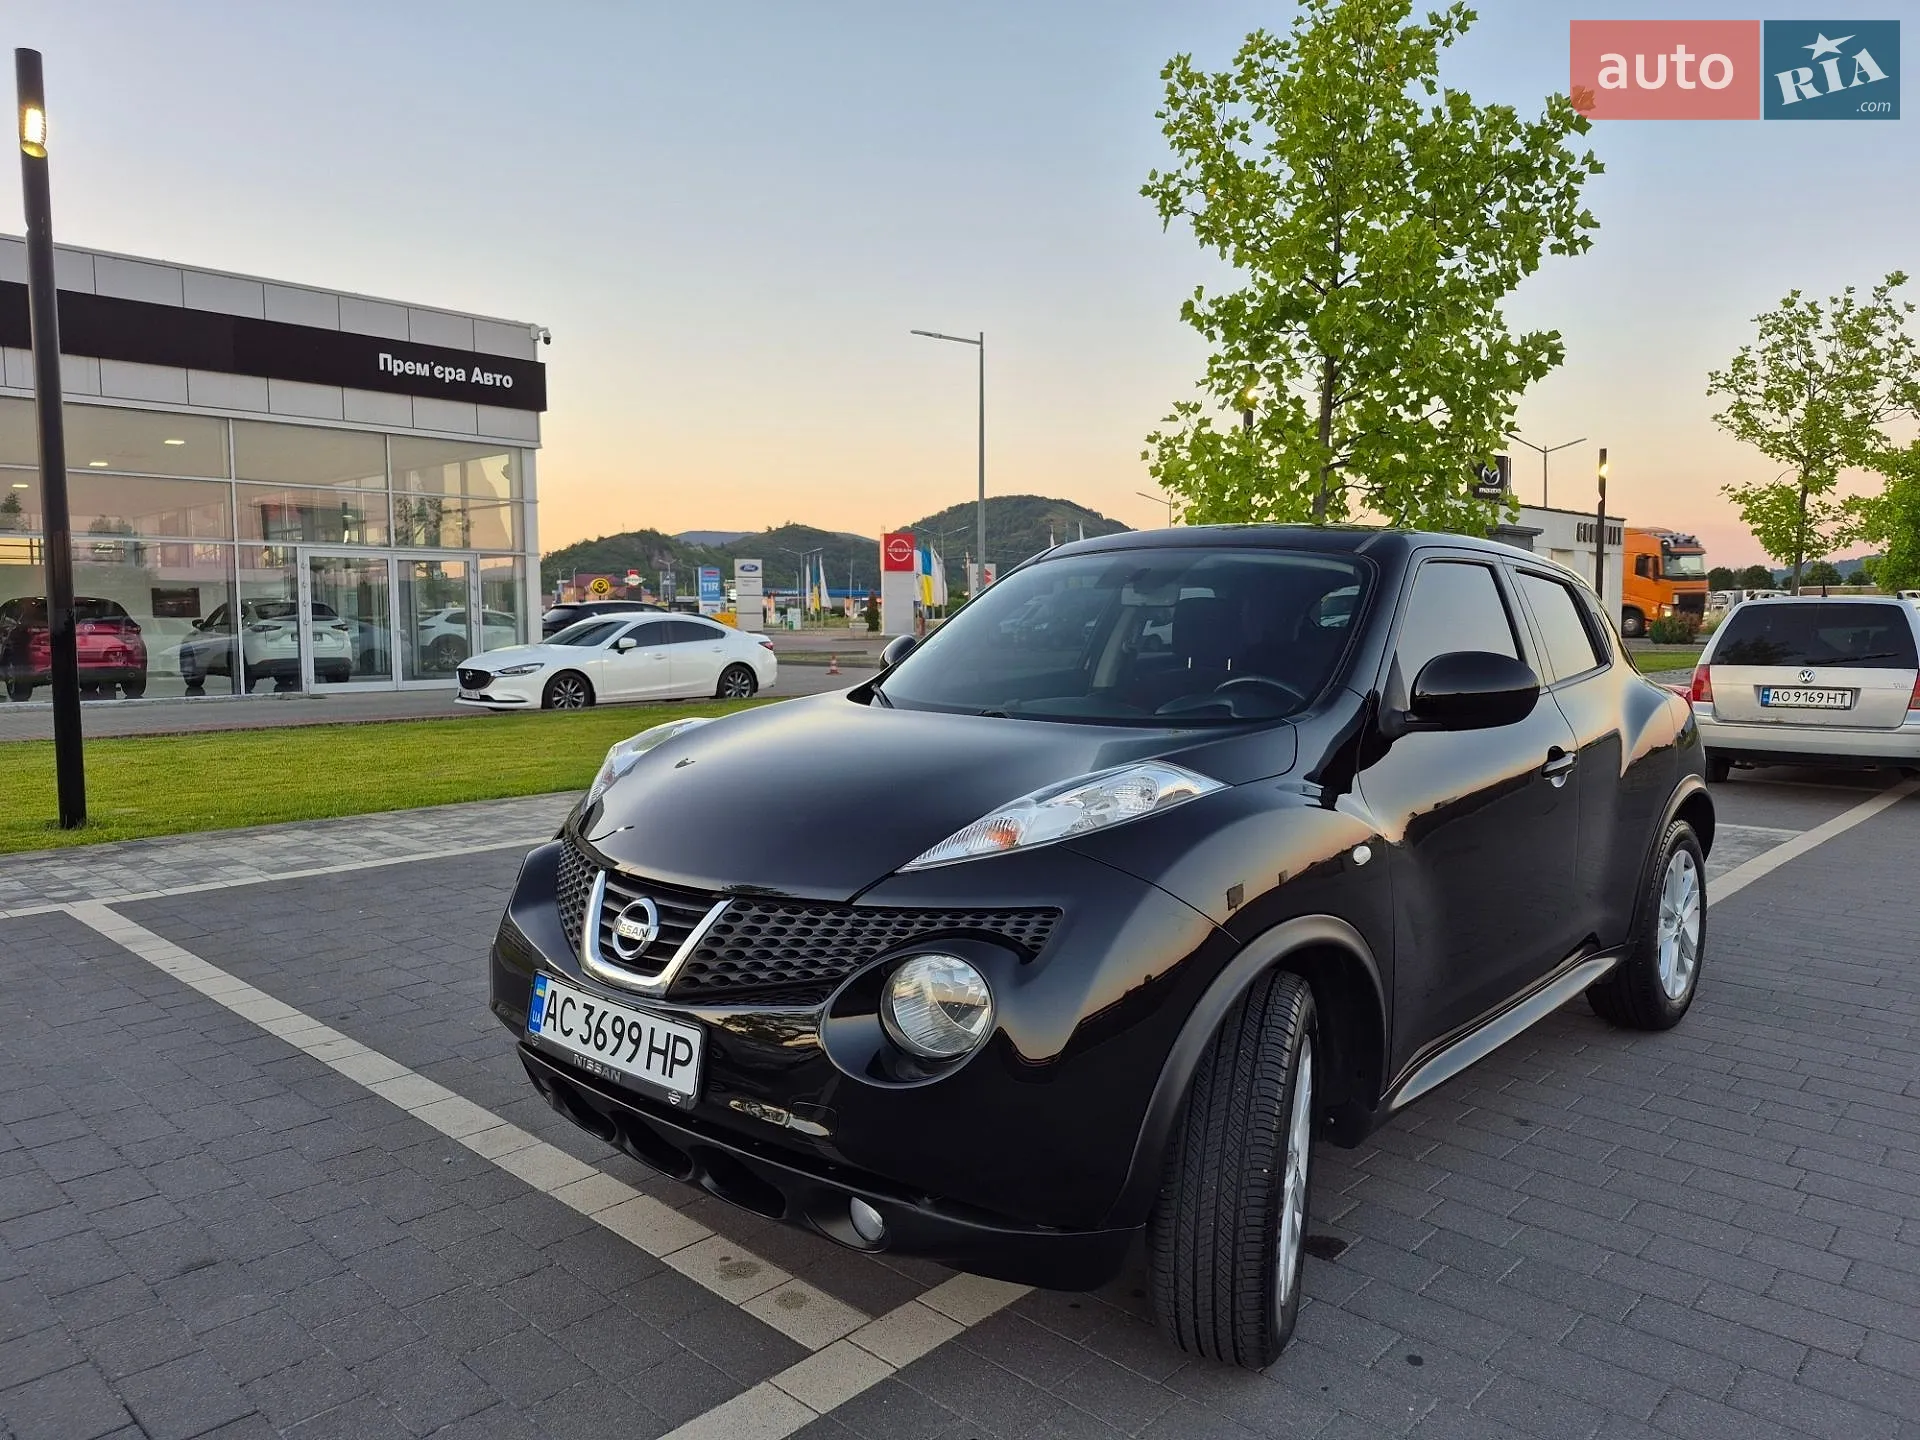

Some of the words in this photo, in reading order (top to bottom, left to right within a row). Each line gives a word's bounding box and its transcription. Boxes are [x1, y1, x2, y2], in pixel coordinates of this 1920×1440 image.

[470, 366, 514, 389] Авто
[702, 581, 719, 592] TIR
[1793, 691, 1825, 704] 9169
[615, 919, 650, 938] NISSAN
[532, 1010, 541, 1026] UA
[542, 989, 577, 1037] AC
[578, 1003, 643, 1064] 3699
[645, 1027, 694, 1079] HP
[573, 1053, 621, 1083] NISSAN
